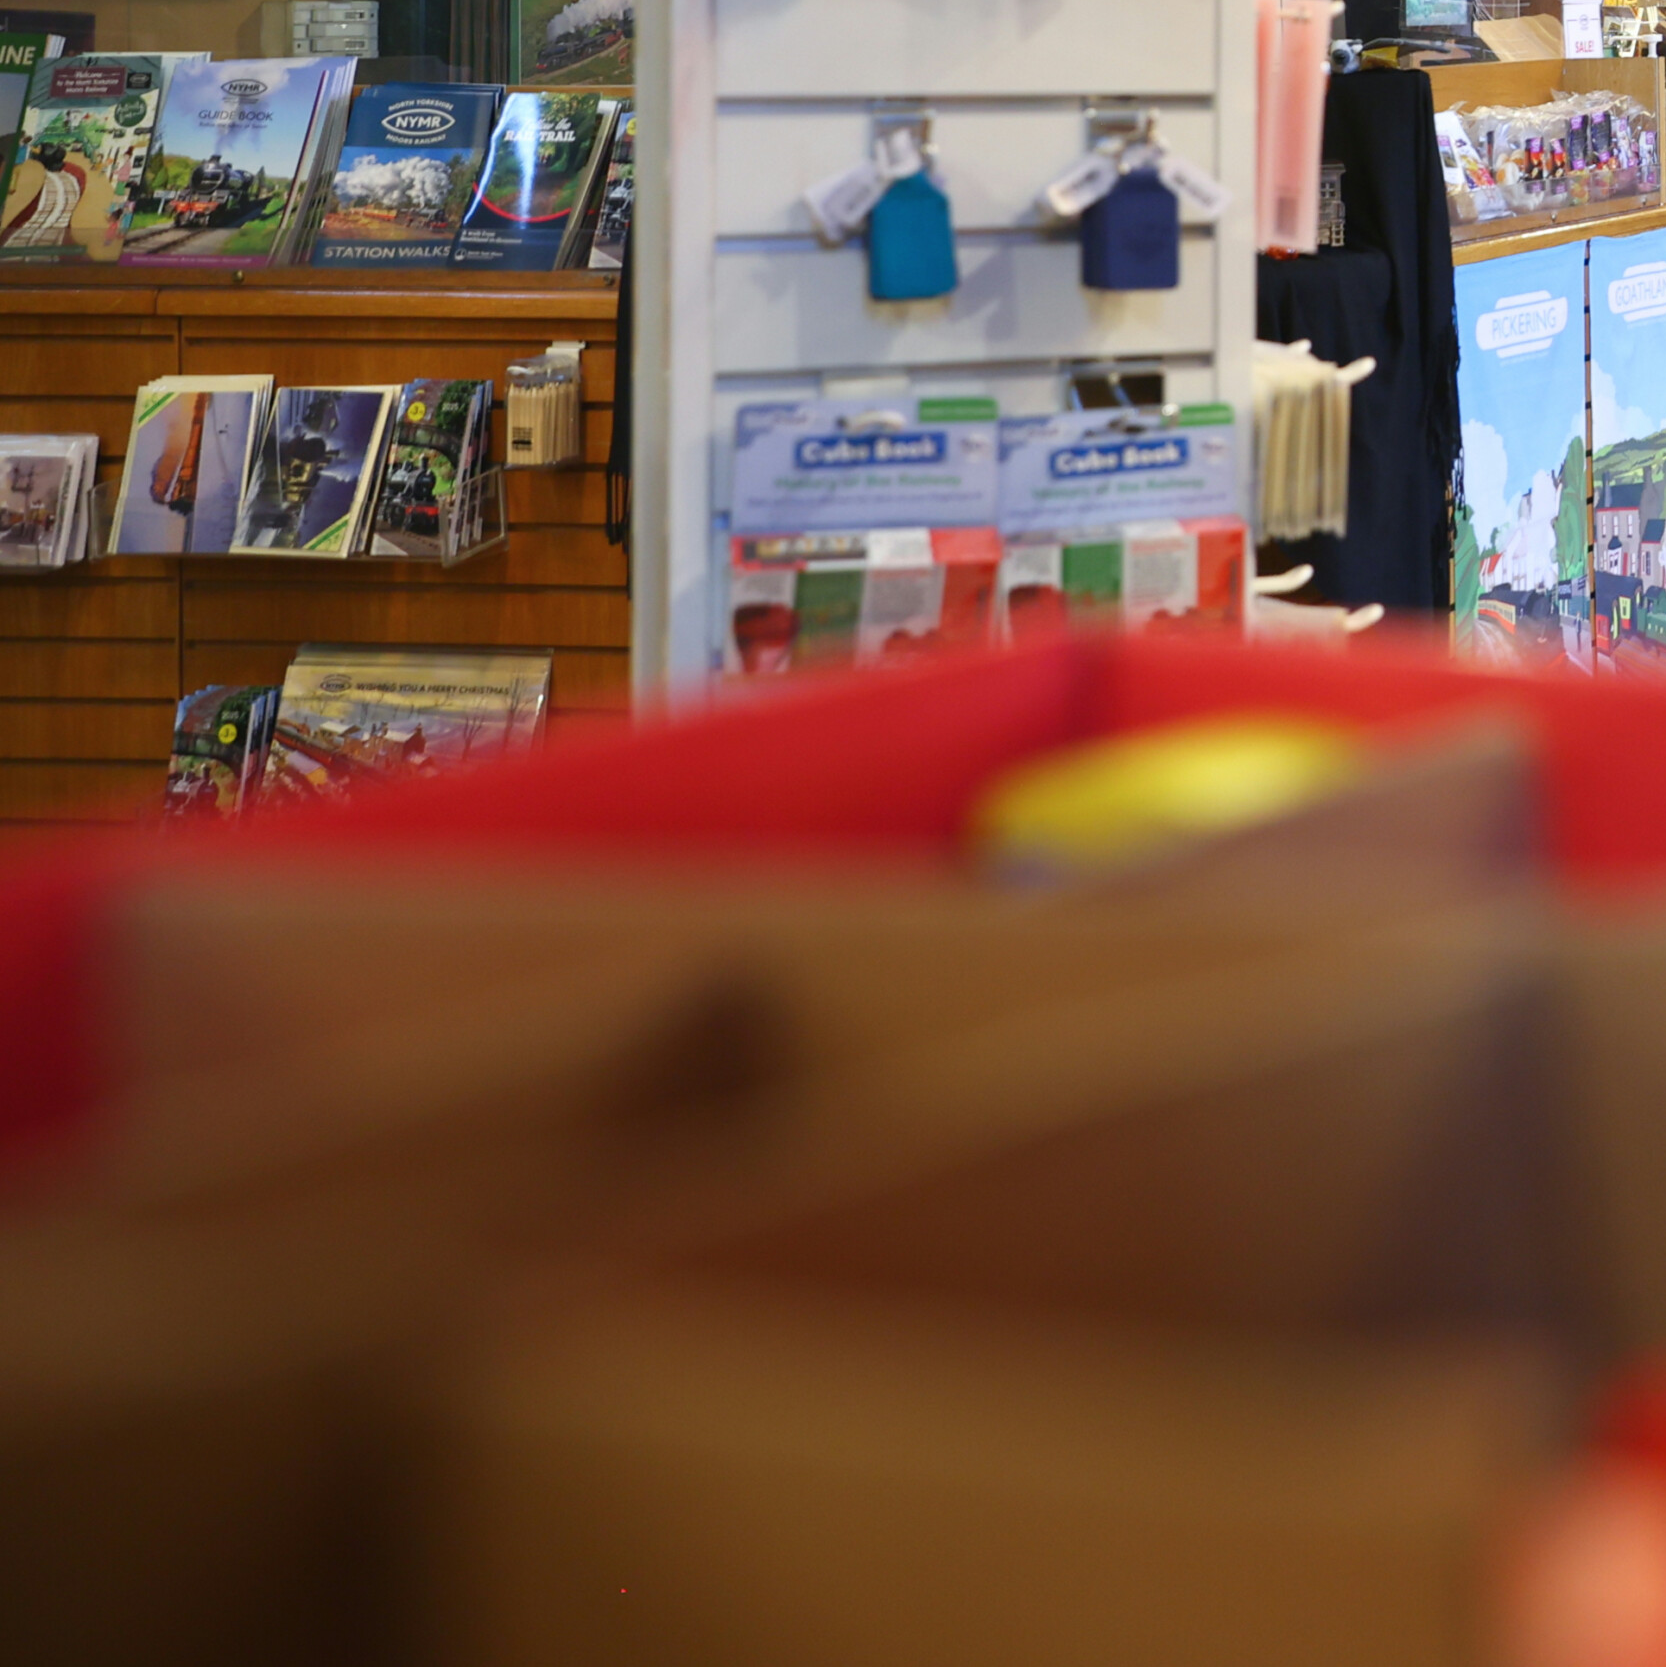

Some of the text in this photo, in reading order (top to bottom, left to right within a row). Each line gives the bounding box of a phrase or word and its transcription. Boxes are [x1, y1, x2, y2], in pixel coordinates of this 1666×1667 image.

[1575, 40, 1595, 54] SALE!
[228, 83, 261, 92] NYMR
[198, 109, 273, 122] GUIDE BOOK
[394, 115, 442, 129] NYMR
[538, 130, 576, 143] TRAIL
[323, 245, 396, 258] STATION
[397, 244, 452, 258] WALKS
[1491, 306, 1557, 342] PICKERING
[399, 683, 421, 693] YOU
[458, 684, 511, 696] CHRISTMAS
